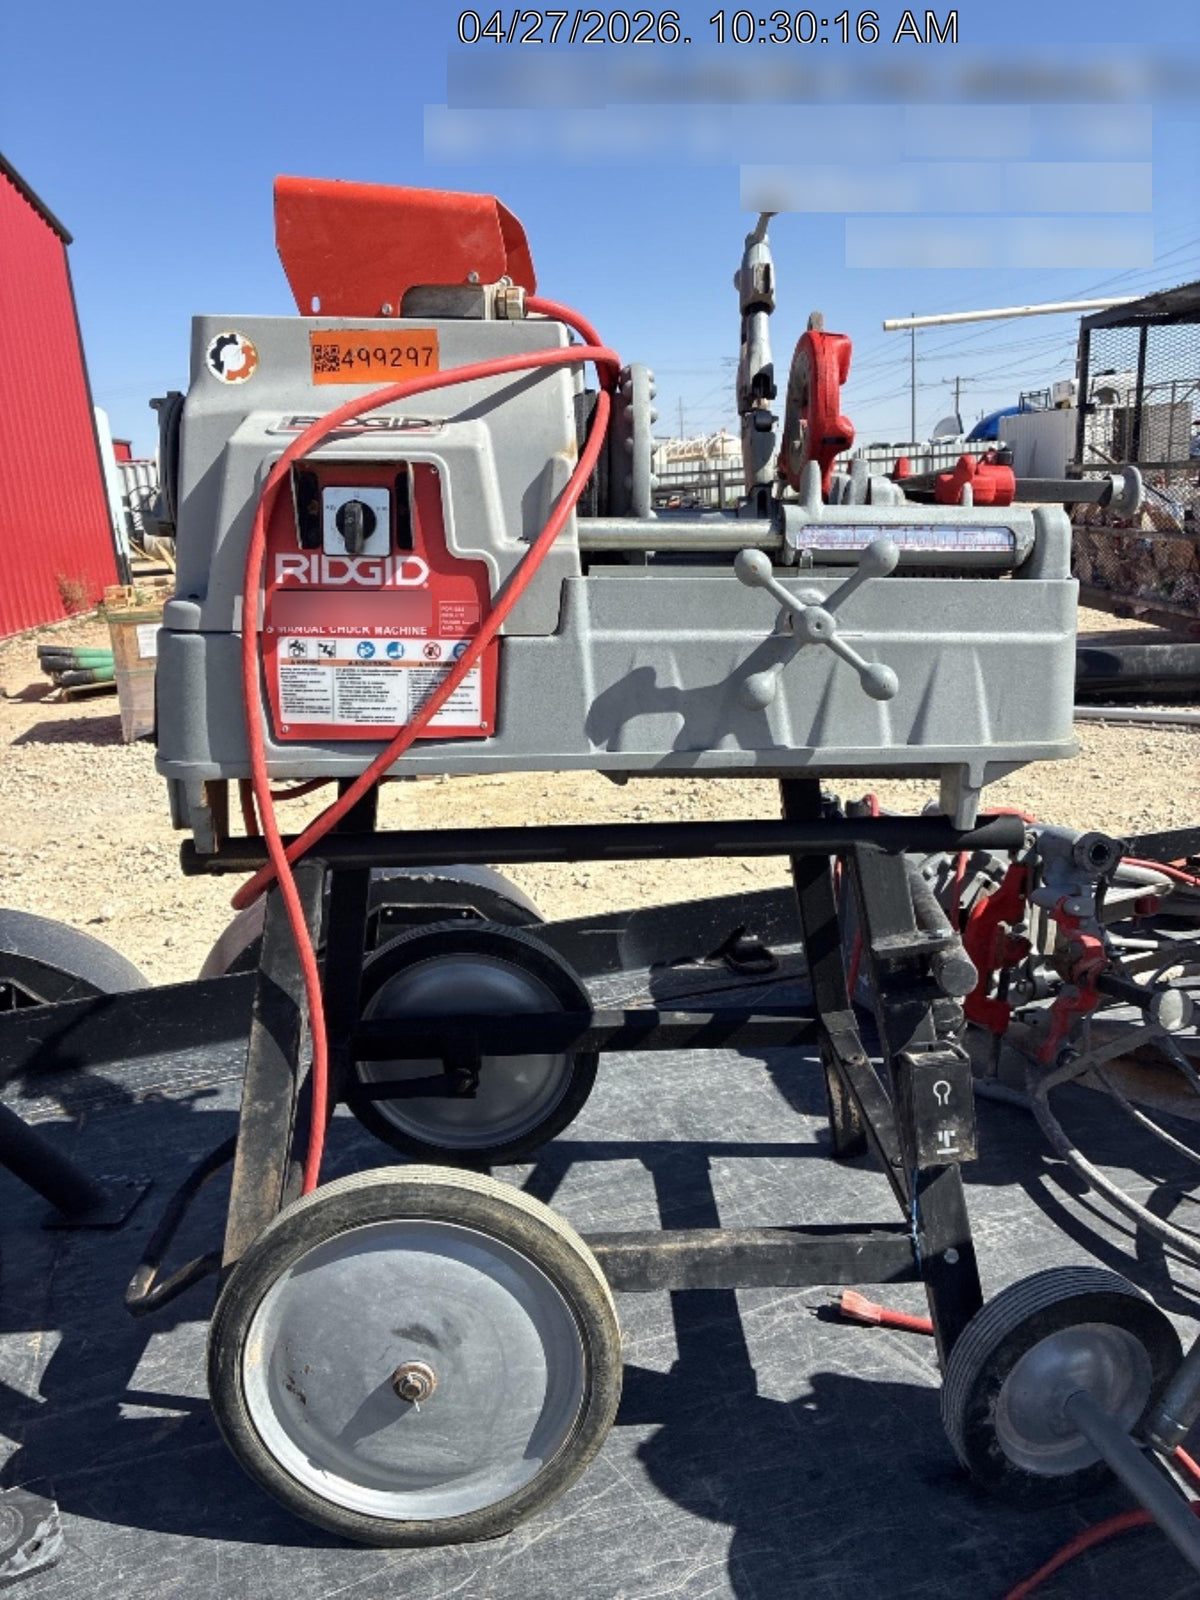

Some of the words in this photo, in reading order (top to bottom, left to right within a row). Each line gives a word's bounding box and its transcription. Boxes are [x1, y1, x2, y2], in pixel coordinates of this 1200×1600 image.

[340, 346, 433, 369] 499297
[289, 416, 433, 428] RDGID
[275, 553, 429, 587] RIDGID
[373, 627, 428, 638] MACHINE
